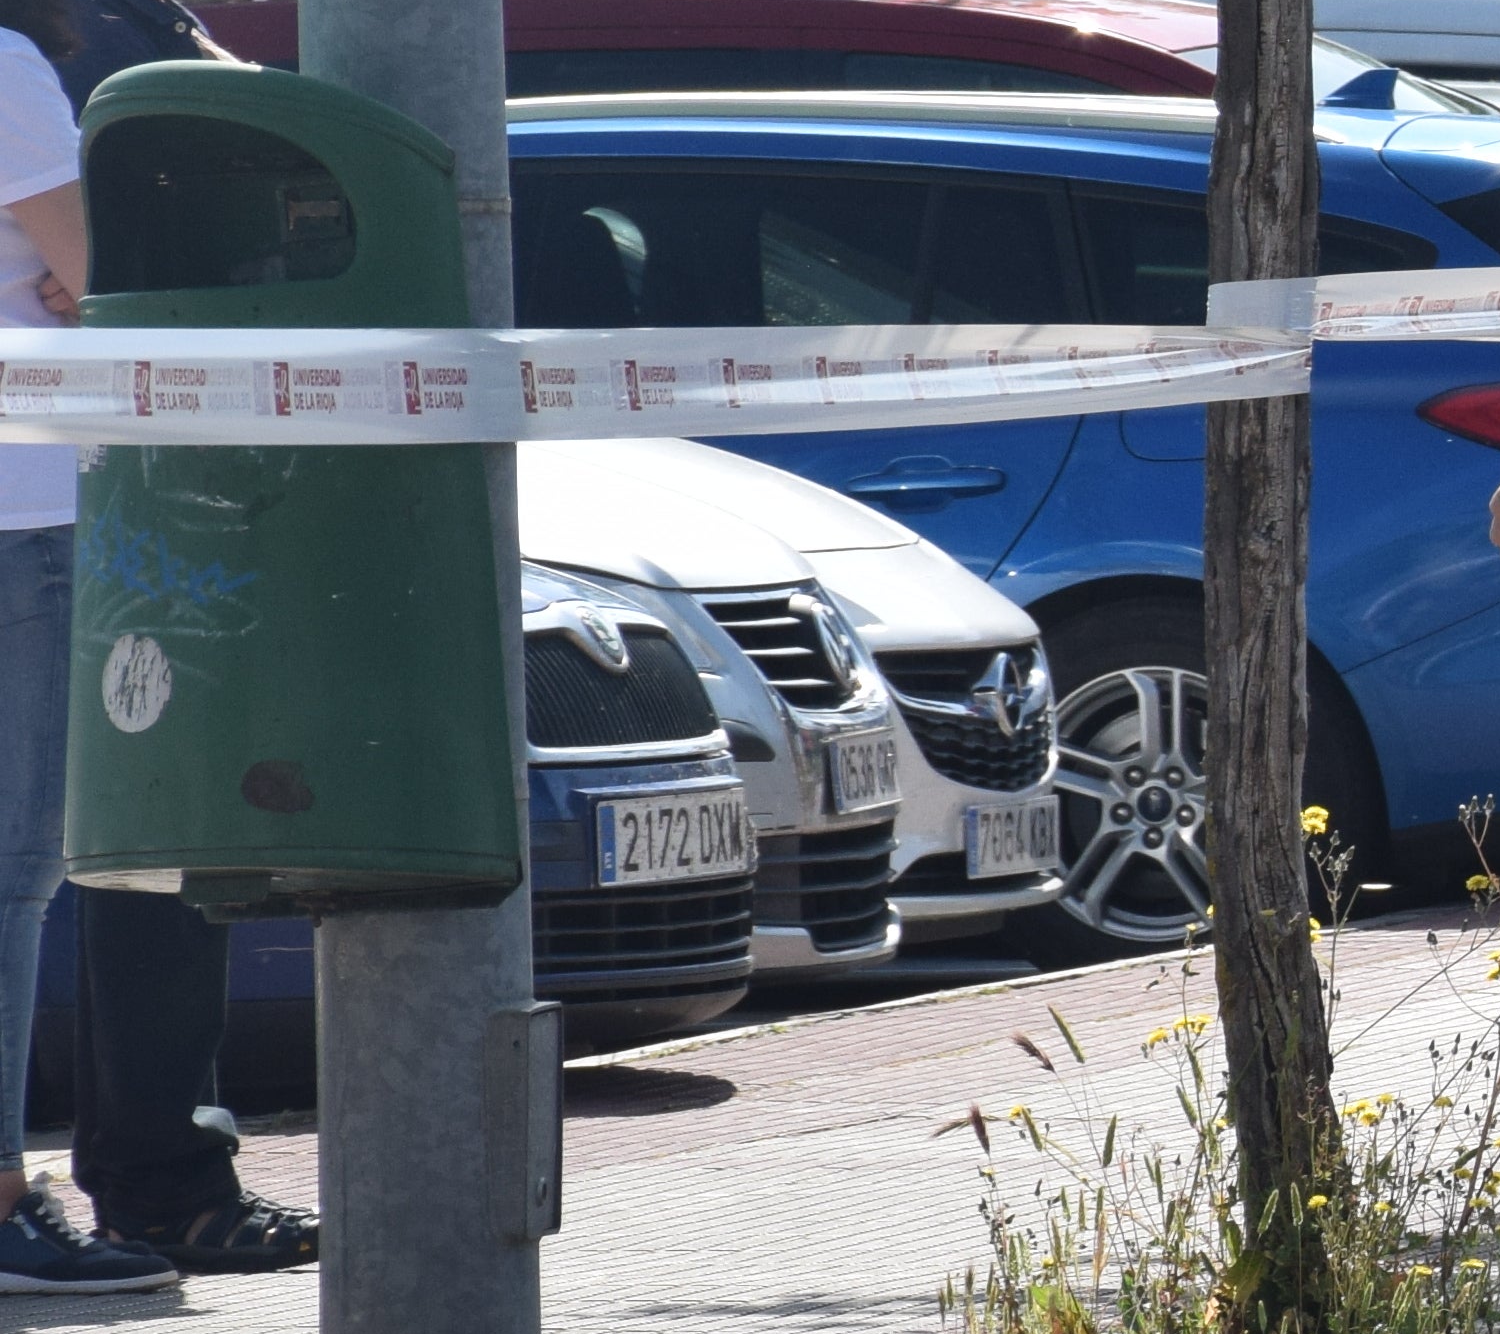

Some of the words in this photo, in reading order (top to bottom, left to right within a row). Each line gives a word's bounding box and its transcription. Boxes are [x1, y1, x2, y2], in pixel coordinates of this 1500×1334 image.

[8, 369, 62, 386] UNIVERSIDAD
[155, 368, 206, 386] UNIVERSIDAD
[294, 369, 341, 386] UNIVERSIDAD
[423, 368, 467, 385] UNIVERSIDAD
[538, 368, 576, 384] UNIVERSIDAD
[156, 393, 166, 410] DE
[167, 394, 178, 410] LA
[179, 393, 200, 413] RIOJA
[294, 393, 304, 410] DE
[305, 393, 315, 410] LA
[316, 393, 336, 413] RIOJA
[425, 392, 433, 409] DE
[434, 392, 443, 408] LA
[444, 392, 463, 411] RIOJA
[622, 807, 692, 871] 2172
